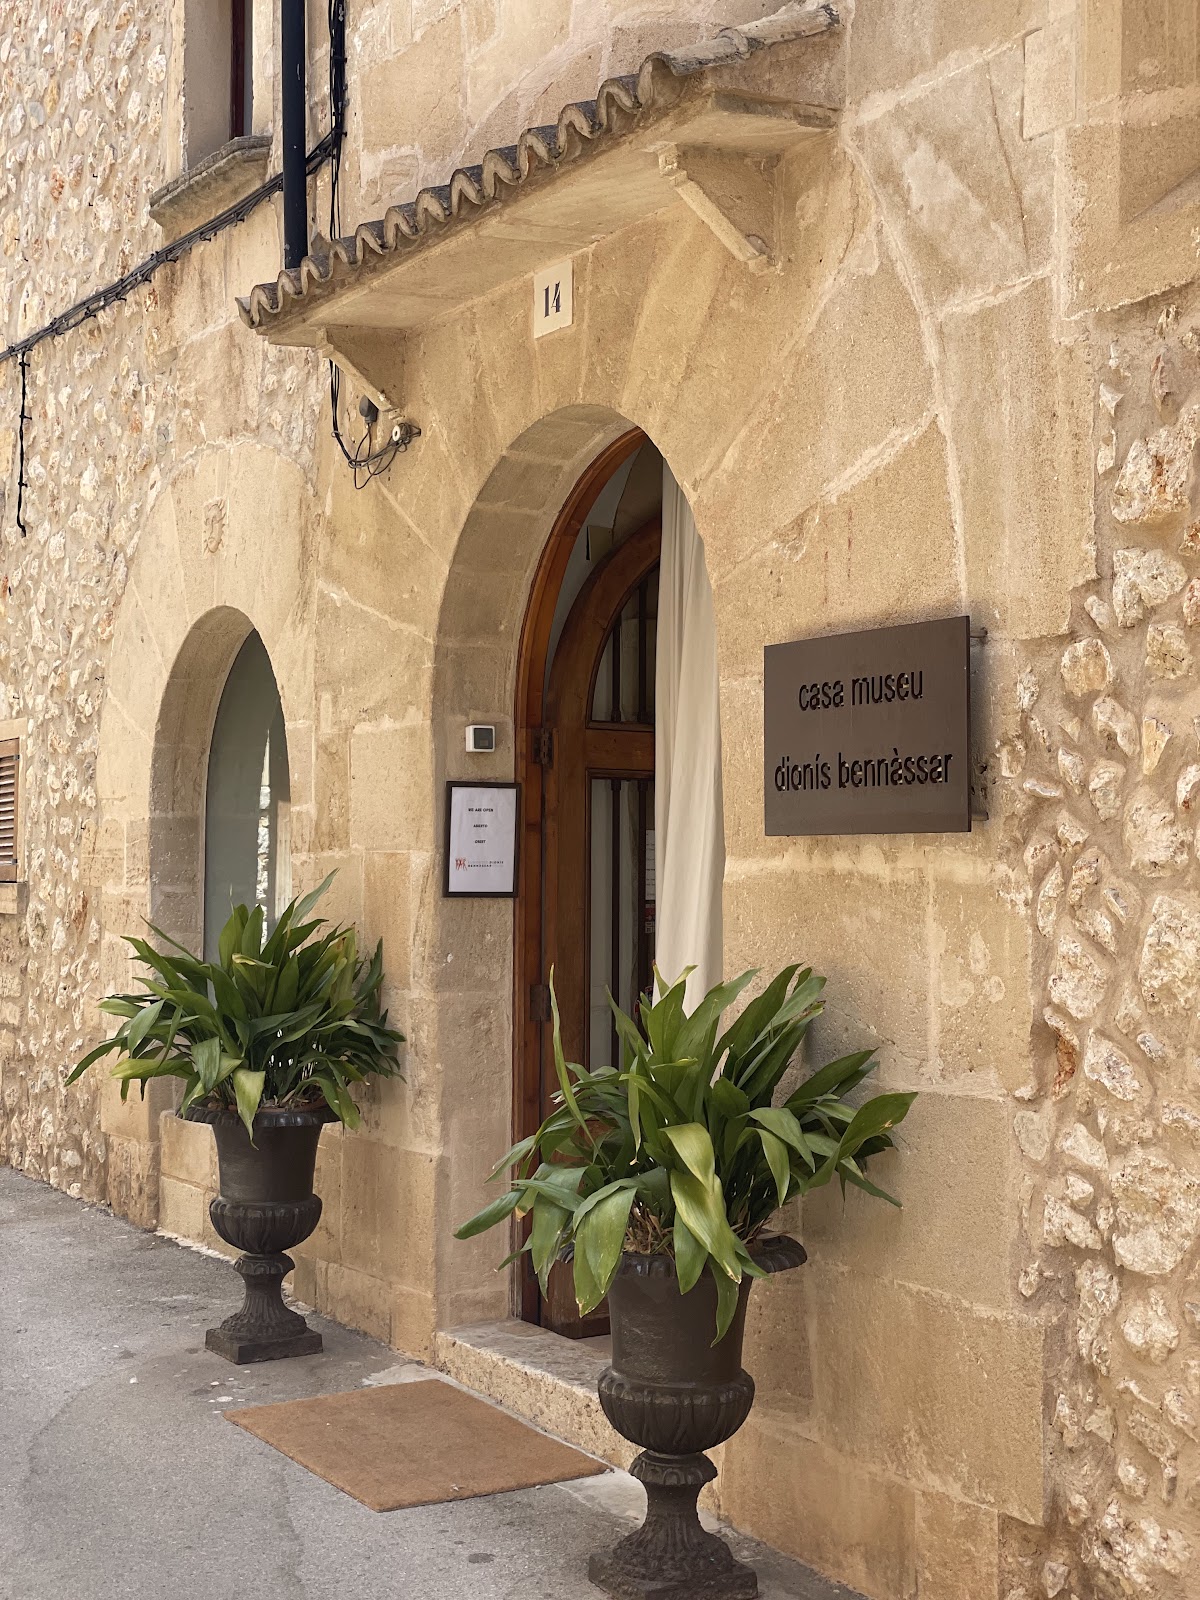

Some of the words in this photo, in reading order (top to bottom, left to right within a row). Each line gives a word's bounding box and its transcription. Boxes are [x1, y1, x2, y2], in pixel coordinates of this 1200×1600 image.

[544, 281, 561, 318] 14
[799, 680, 844, 711] casa
[851, 671, 923, 705] museu
[774, 753, 831, 791] dionís
[838, 748, 953, 789] bennàssar
